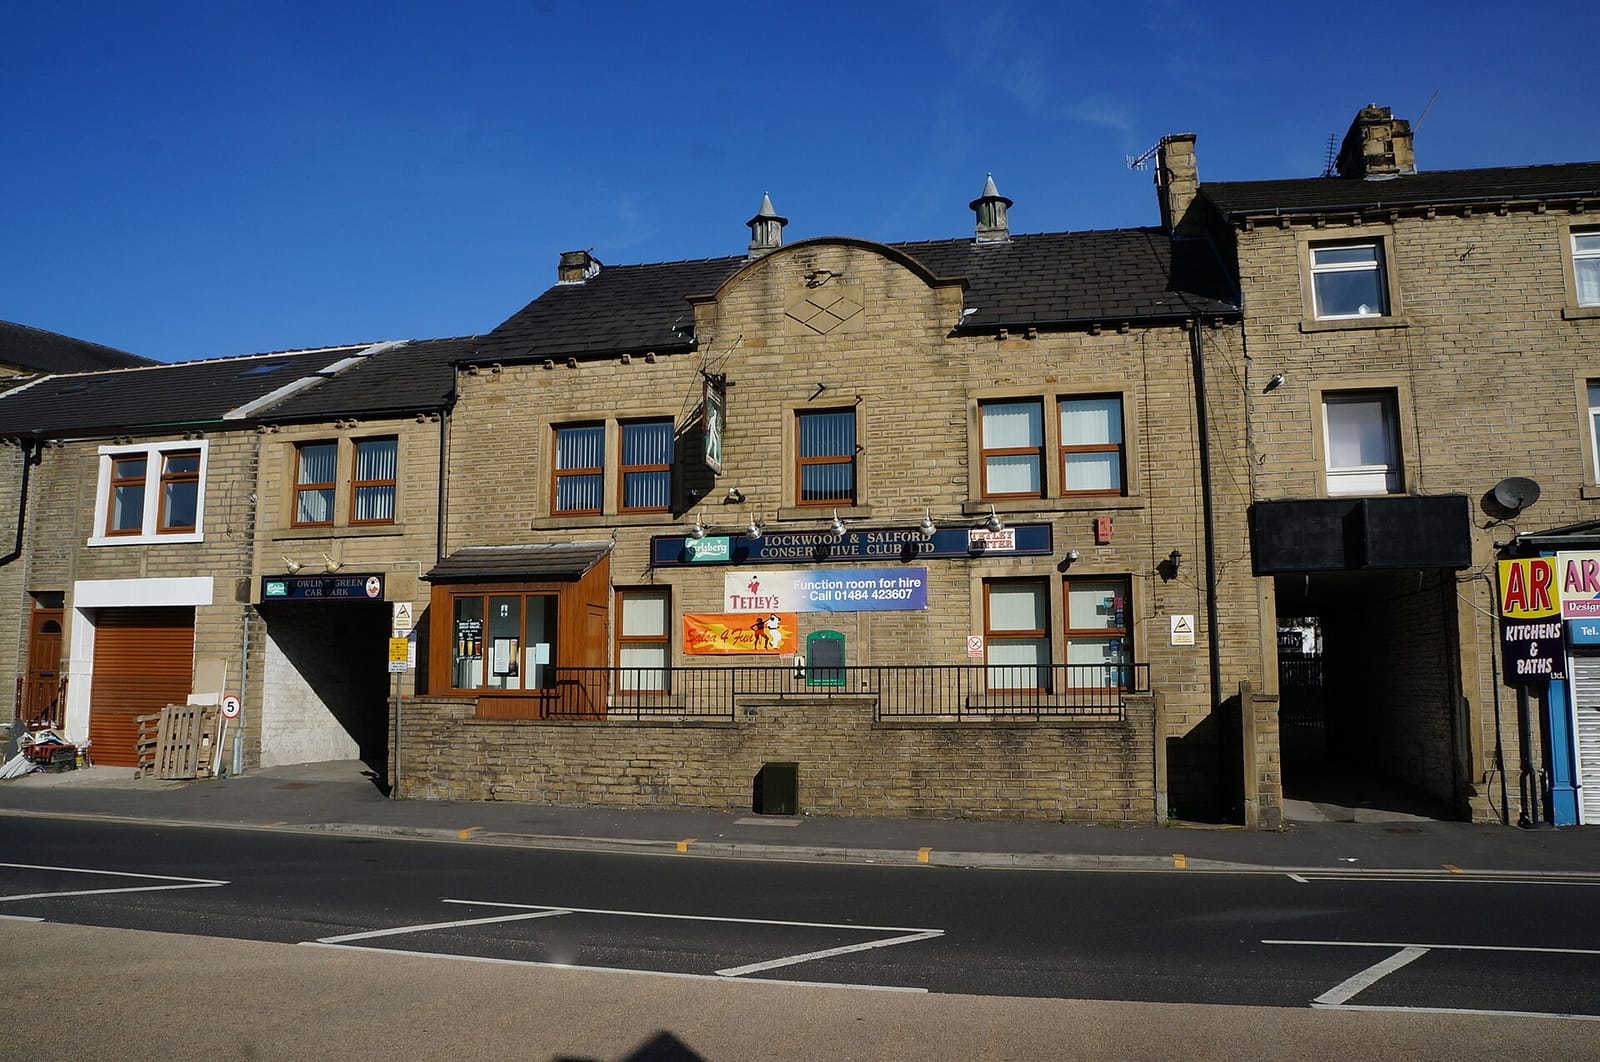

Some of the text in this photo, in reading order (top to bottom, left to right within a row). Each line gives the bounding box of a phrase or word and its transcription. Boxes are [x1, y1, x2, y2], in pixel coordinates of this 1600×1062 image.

[687, 538, 727, 553] Carlsberg
[764, 531, 932, 547] LOCKWOOD & SALFORD
[760, 545, 859, 558] CONSERVATIVE
[866, 543, 902, 555] CLUB
[1564, 559, 1600, 593] AR
[793, 577, 922, 591] Function room for hire
[1504, 560, 1553, 613] AR
[304, 588, 322, 597] CAR
[810, 590, 832, 601] Call
[834, 589, 868, 600] 01484
[871, 588, 912, 600] 423607
[730, 594, 779, 609] TETLEY'S
[686, 628, 754, 645] Salsa 4 Fun
[1506, 623, 1561, 642] KITCHENS
[1580, 627, 1599, 636] Tel.
[1529, 642, 1538, 657] &
[1517, 658, 1552, 674] BATHS
[227, 701, 235, 712] 5
